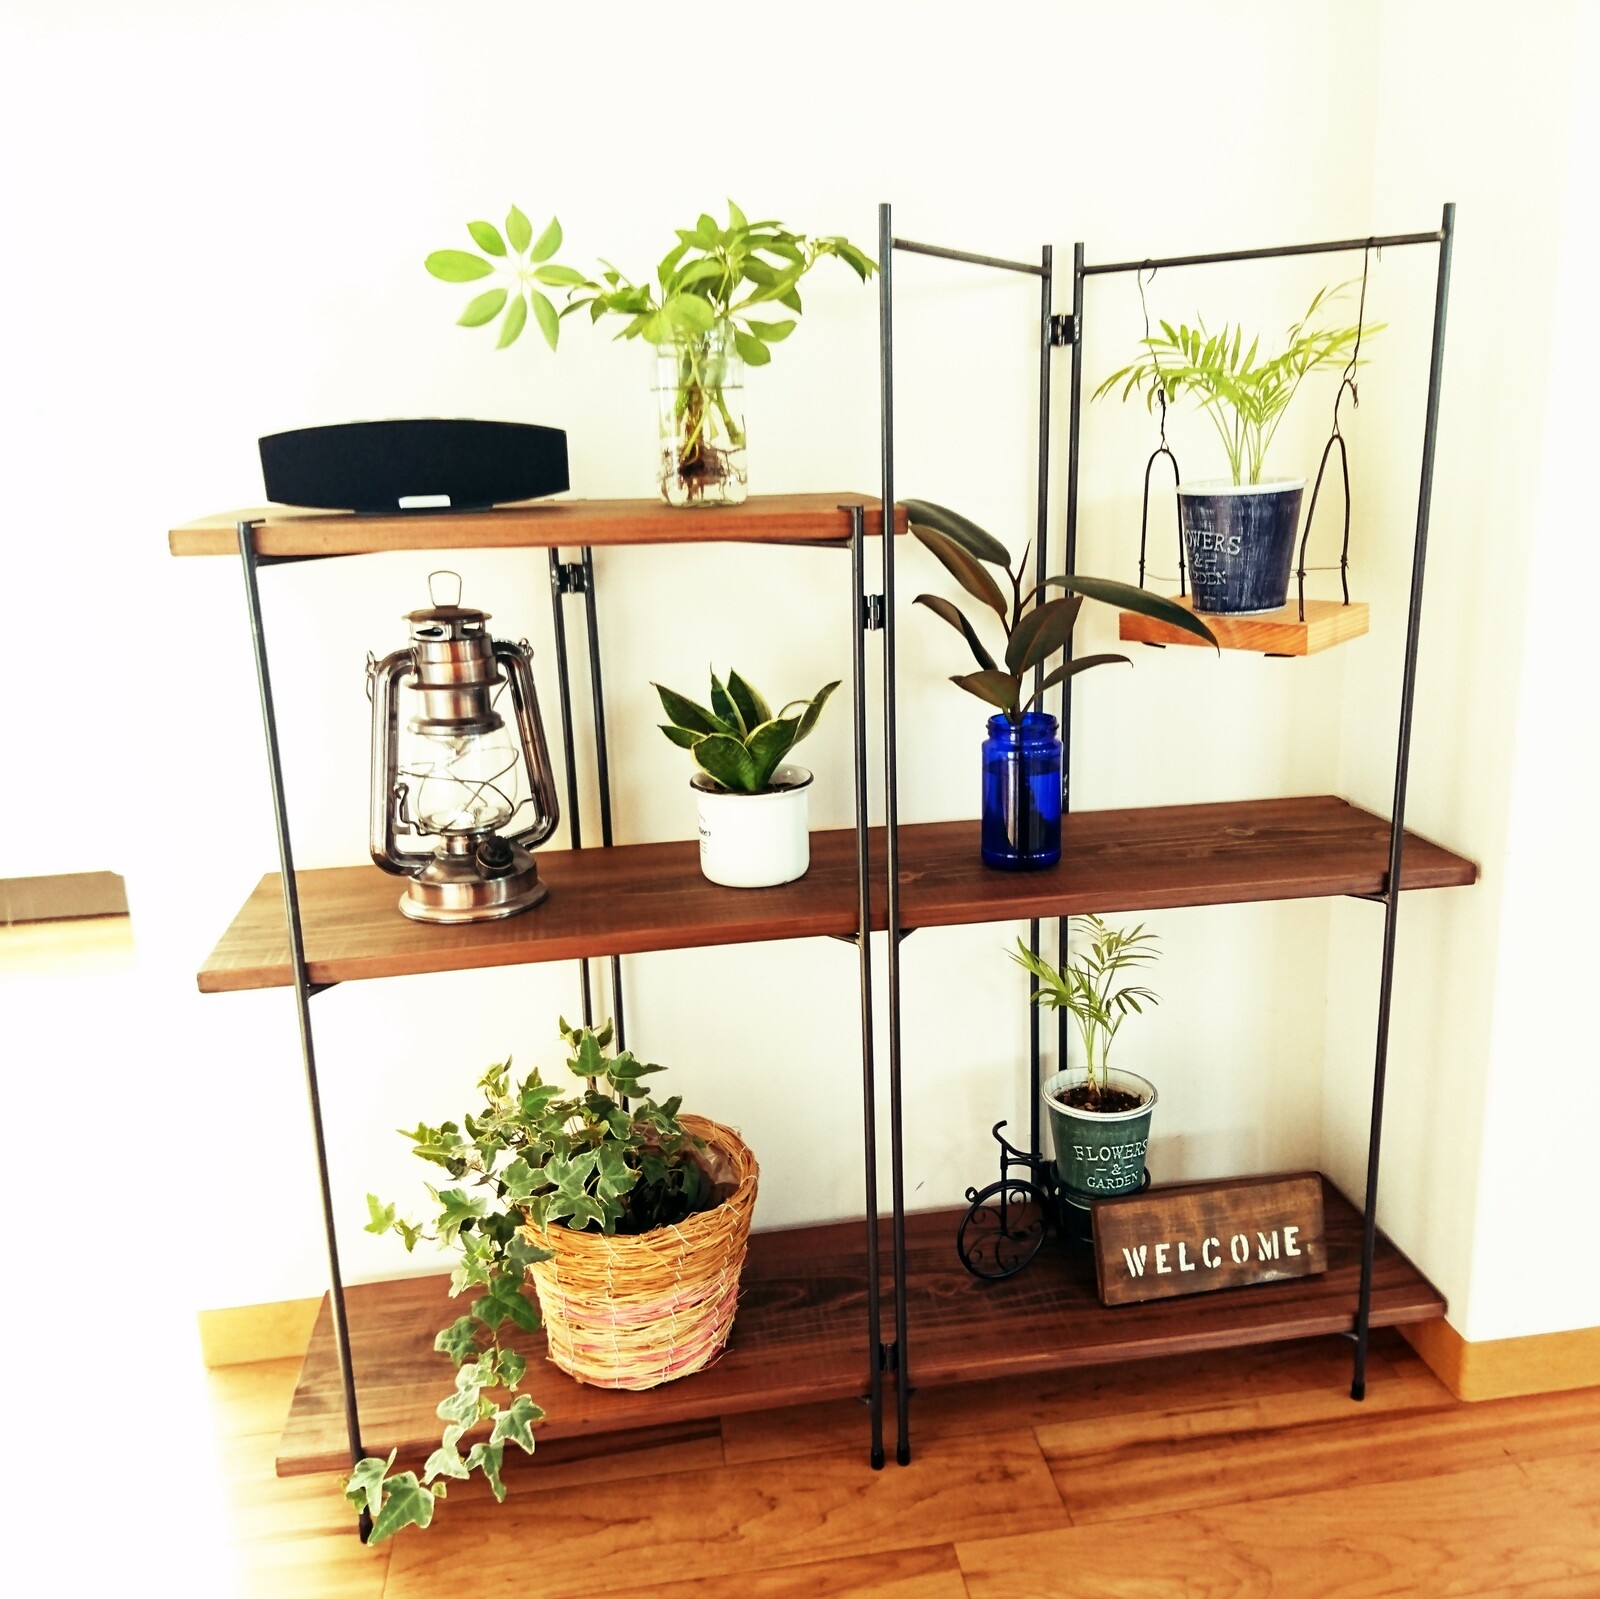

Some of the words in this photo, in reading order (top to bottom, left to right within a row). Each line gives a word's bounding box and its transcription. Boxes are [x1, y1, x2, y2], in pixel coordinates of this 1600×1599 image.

[1190, 570, 1226, 586] RDEN
[1073, 1138, 1148, 1161] FLOWERS
[1111, 1163, 1122, 1176] &
[1086, 1170, 1139, 1189] GARDEN
